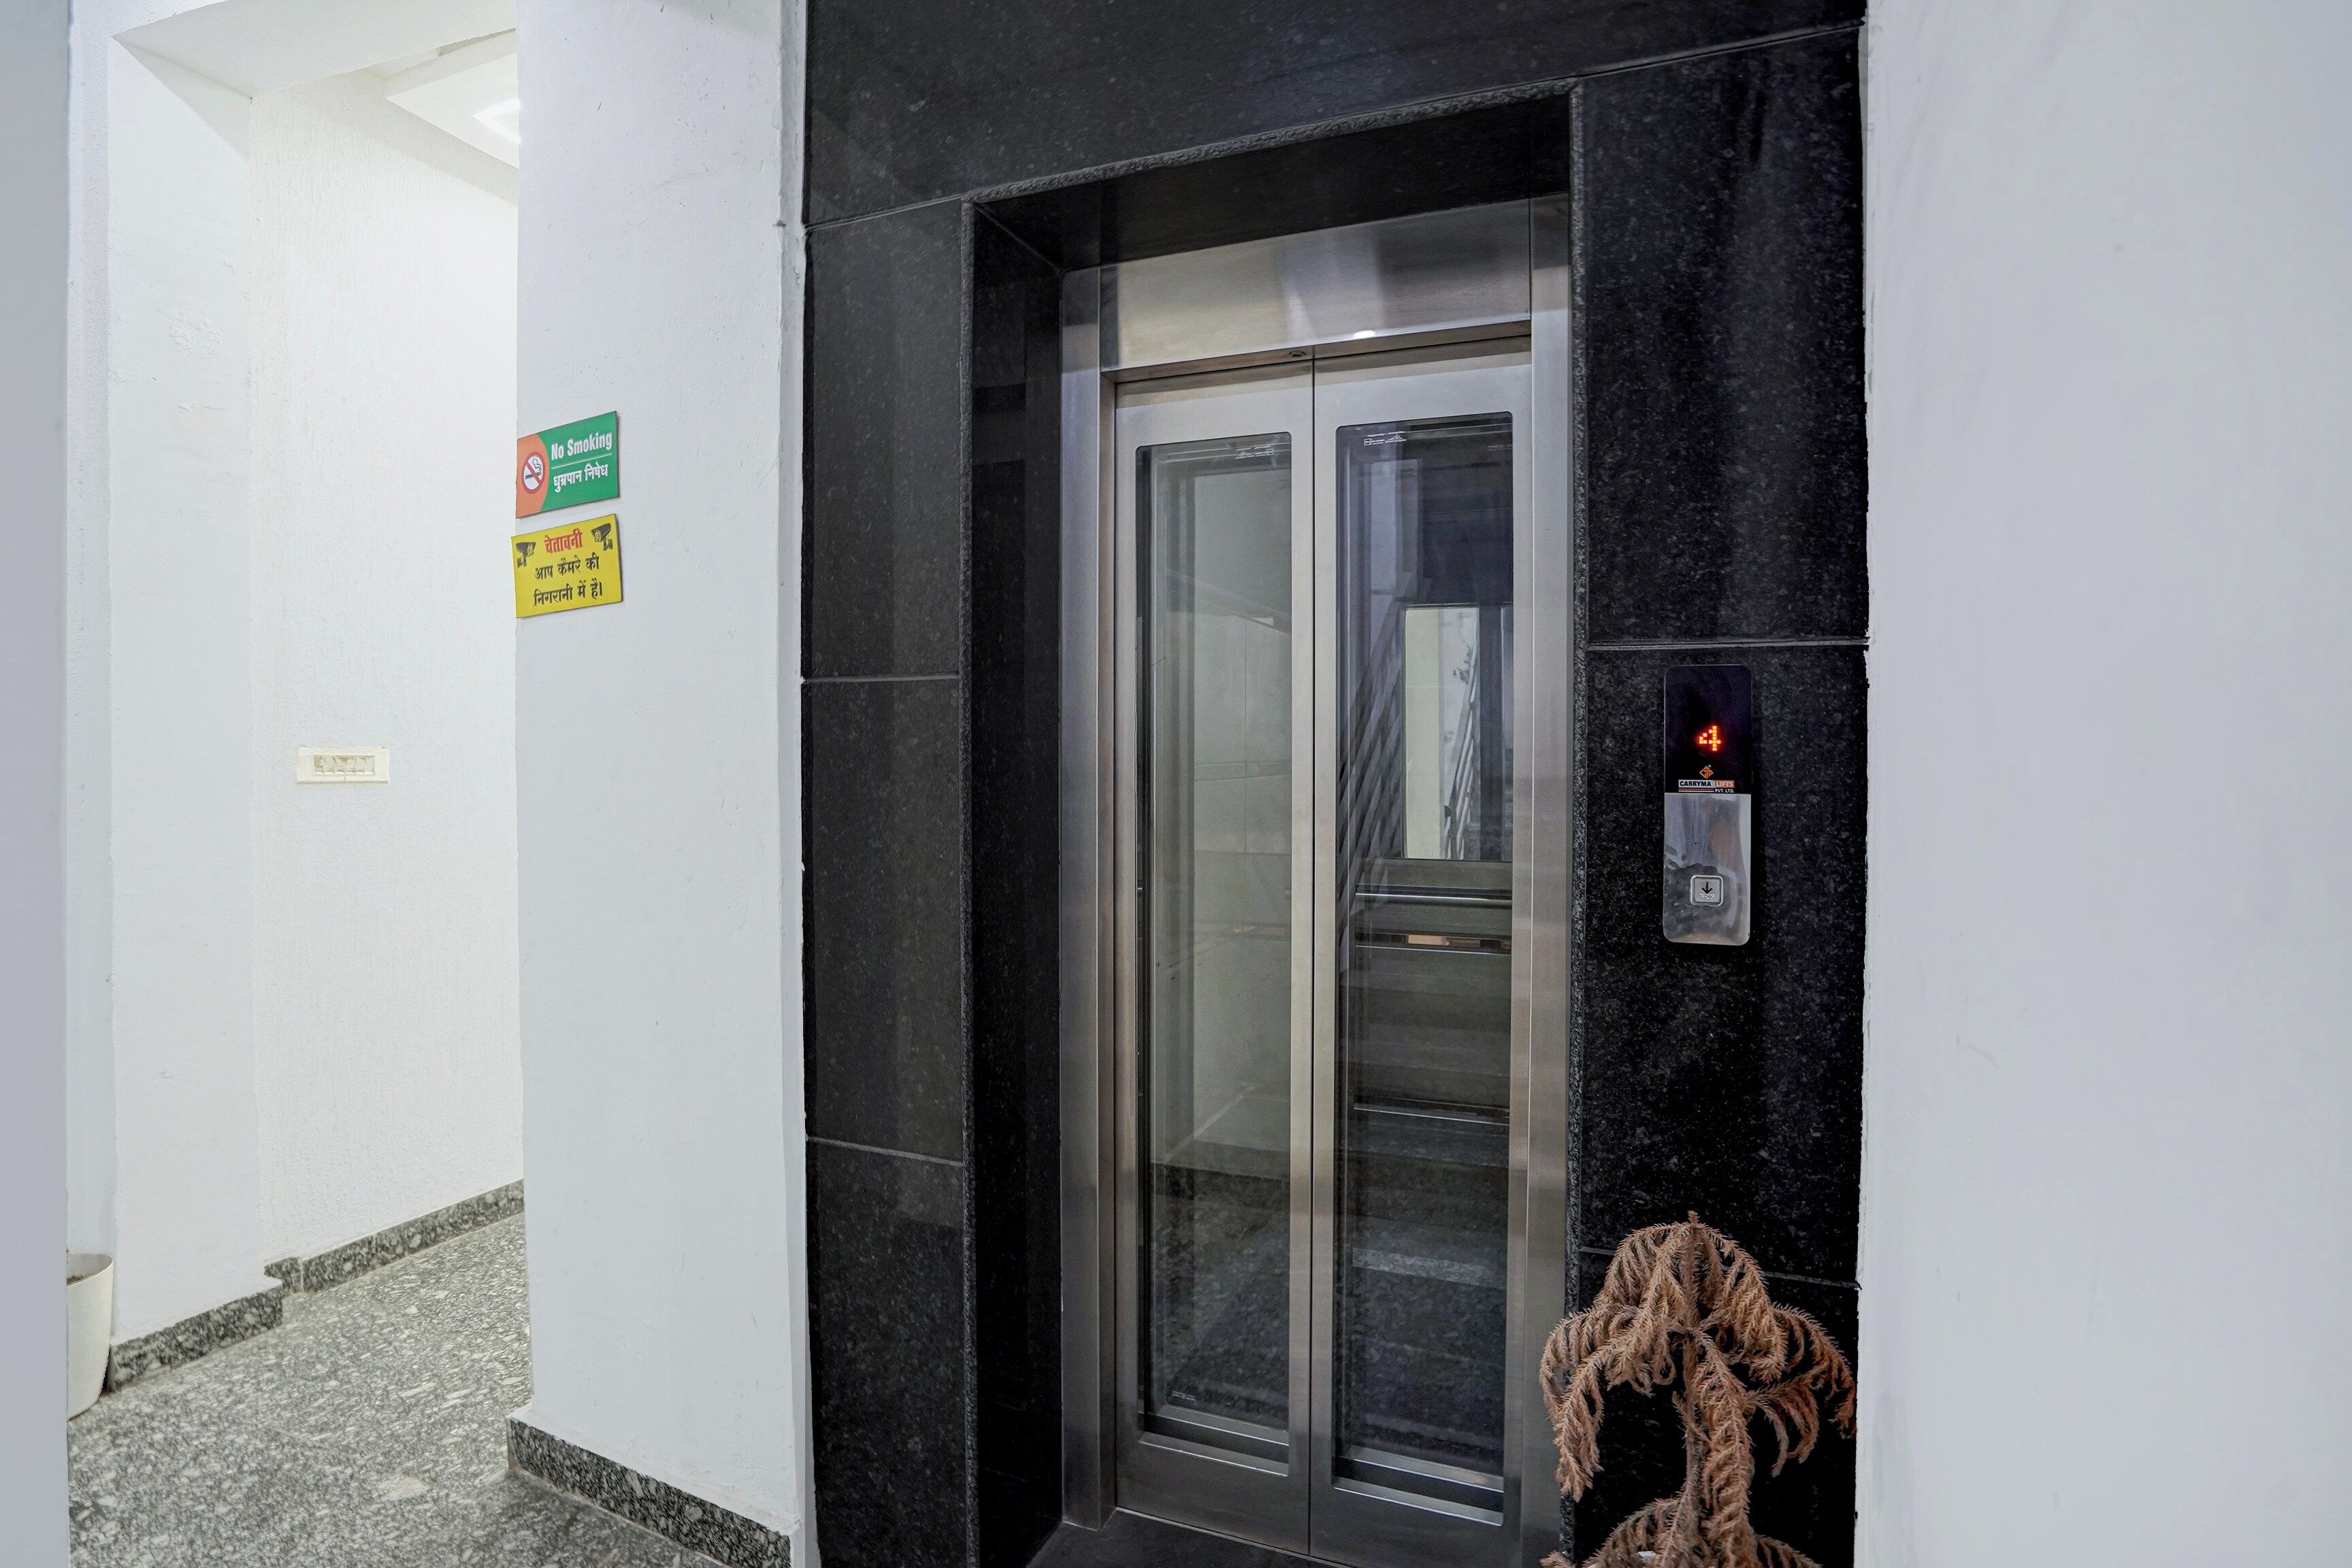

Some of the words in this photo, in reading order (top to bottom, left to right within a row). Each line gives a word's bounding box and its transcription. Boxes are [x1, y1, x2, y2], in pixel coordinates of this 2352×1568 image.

[551, 443, 564, 461] No
[567, 431, 612, 457] Smoking
[584, 461, 608, 481] निषेध
[544, 528, 583, 554] चेतावनी
[534, 566, 553, 581] आप
[585, 552, 600, 570] की
[534, 583, 573, 606] निगरानी
[577, 580, 586, 598] में
[1699, 725, 1721, 751] 4
